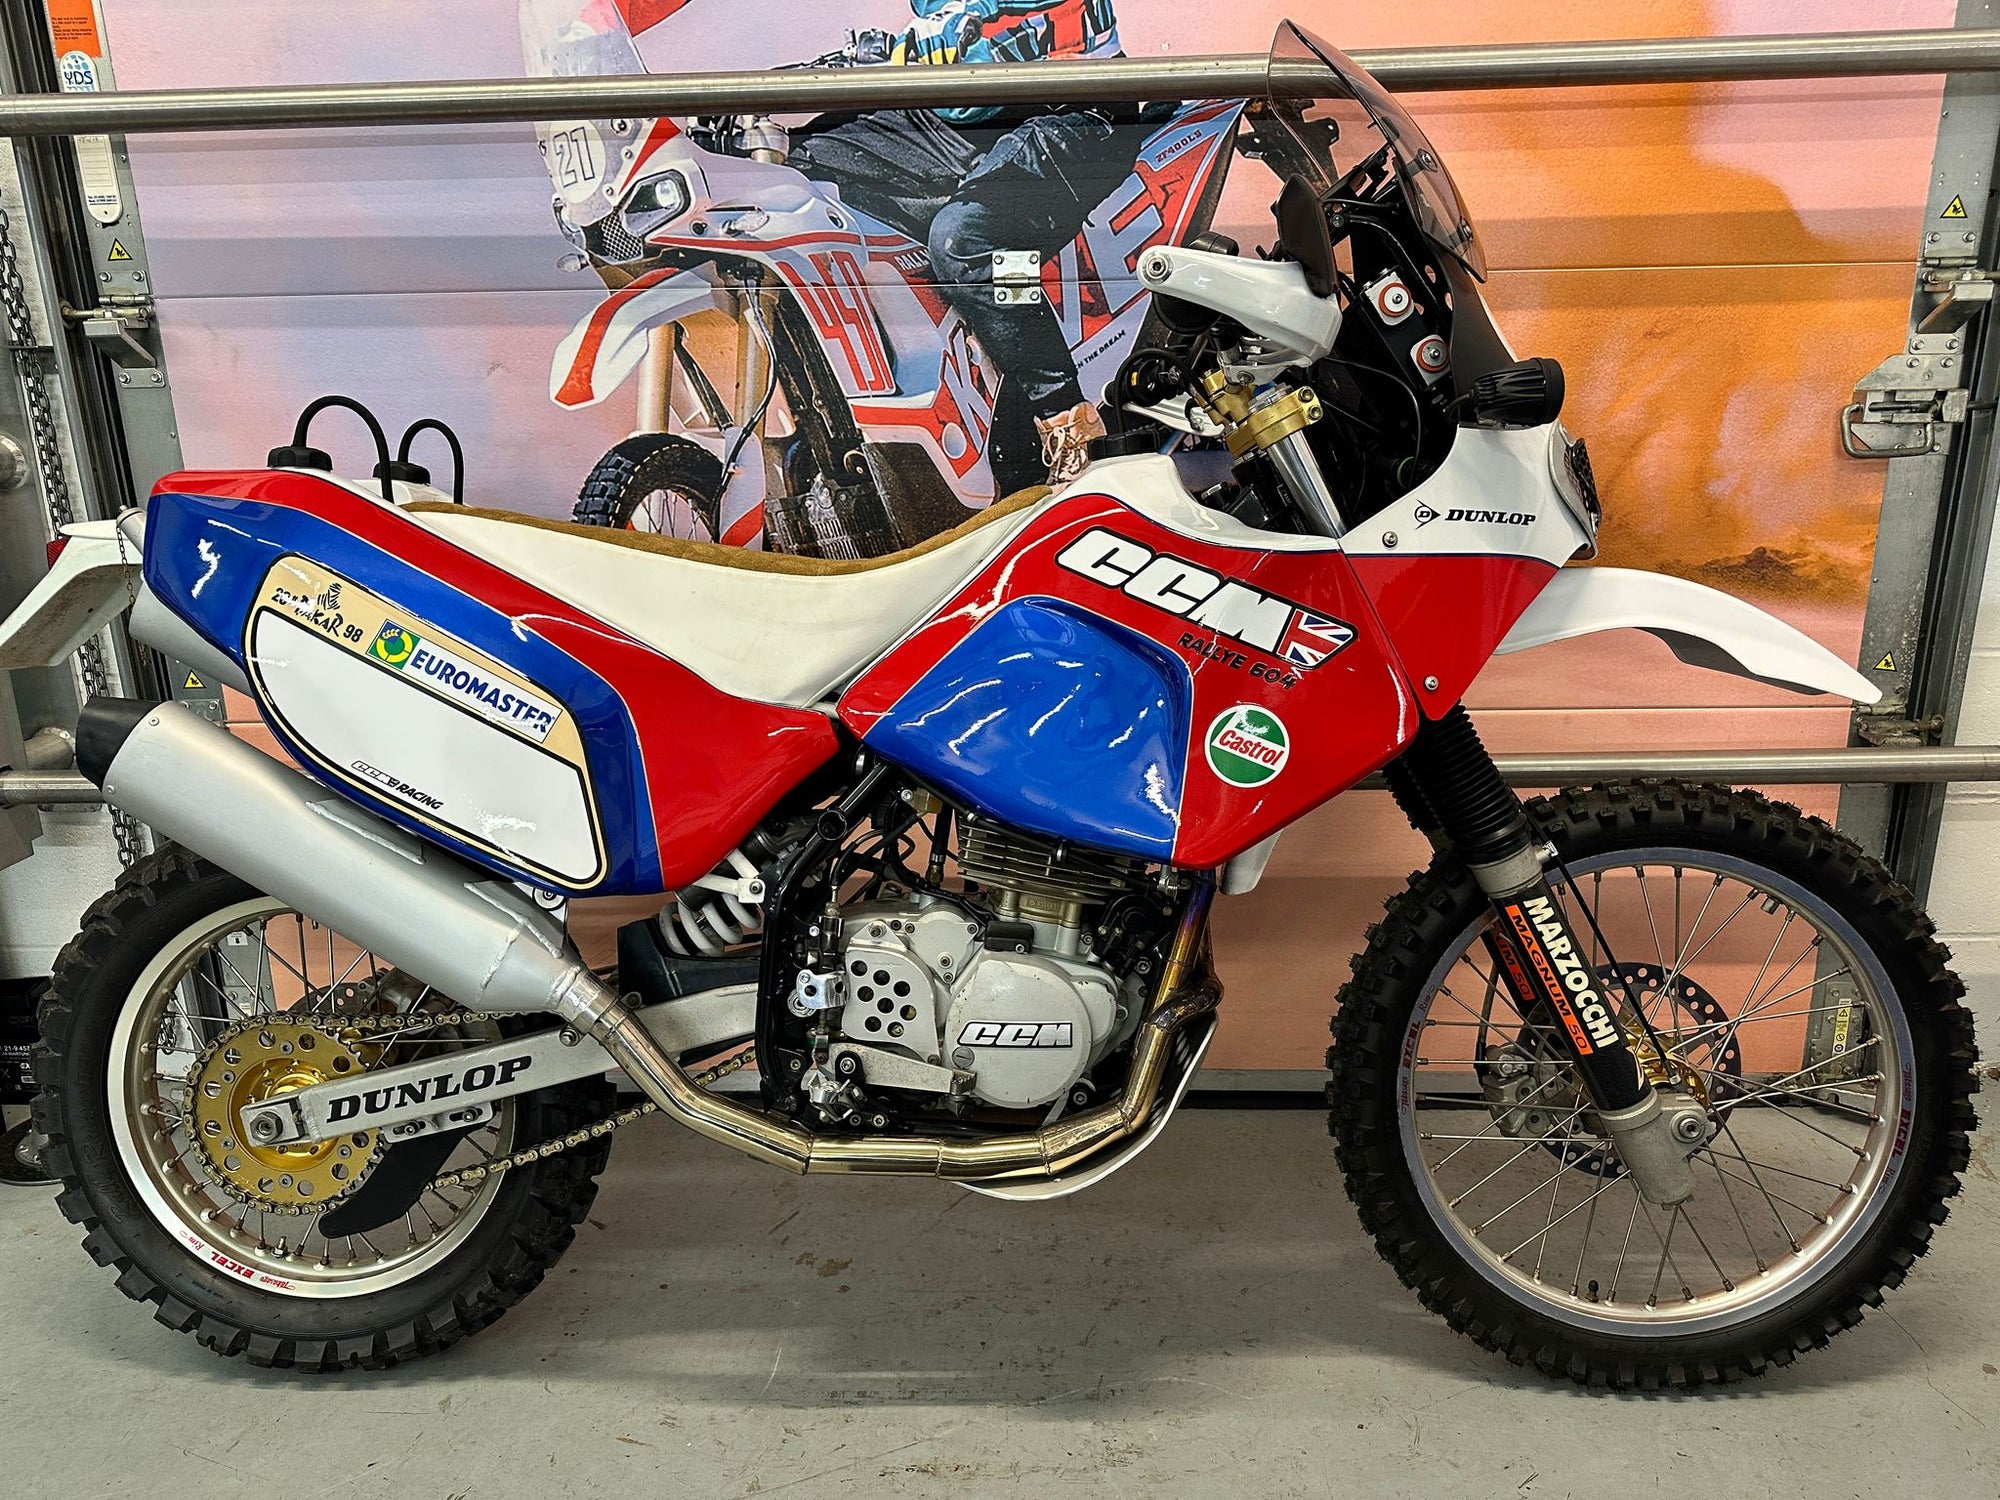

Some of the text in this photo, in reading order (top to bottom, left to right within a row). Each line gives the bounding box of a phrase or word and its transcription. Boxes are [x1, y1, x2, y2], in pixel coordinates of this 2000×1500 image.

[63, 70, 94, 86] YDS
[553, 126, 595, 188] 21
[894, 249, 930, 271] RALLY
[1084, 329, 1126, 363] THE DREAM
[1445, 509, 1536, 526] DUNLOP
[1056, 526, 1290, 655] CCM
[343, 624, 364, 643] 98
[1177, 632, 1298, 690] RALLYE 604
[410, 648, 553, 733] EUROMASTER
[1218, 728, 1284, 767] Castrol
[396, 783, 444, 810] RACING
[1512, 914, 1588, 1049] MAGNUM 50
[1514, 974, 1530, 993] 50
[1523, 895, 1619, 1049] MARZOCCHI
[957, 1021, 1073, 1048] CCM
[1402, 1020, 1421, 1069] EXCEL
[1418, 994, 1431, 1013] Rim
[326, 1055, 532, 1123] DUNLOP
[1891, 1108, 1912, 1159] EXCEL
[188, 1236, 204, 1251] Rim
[210, 1251, 256, 1279] EXCEL
